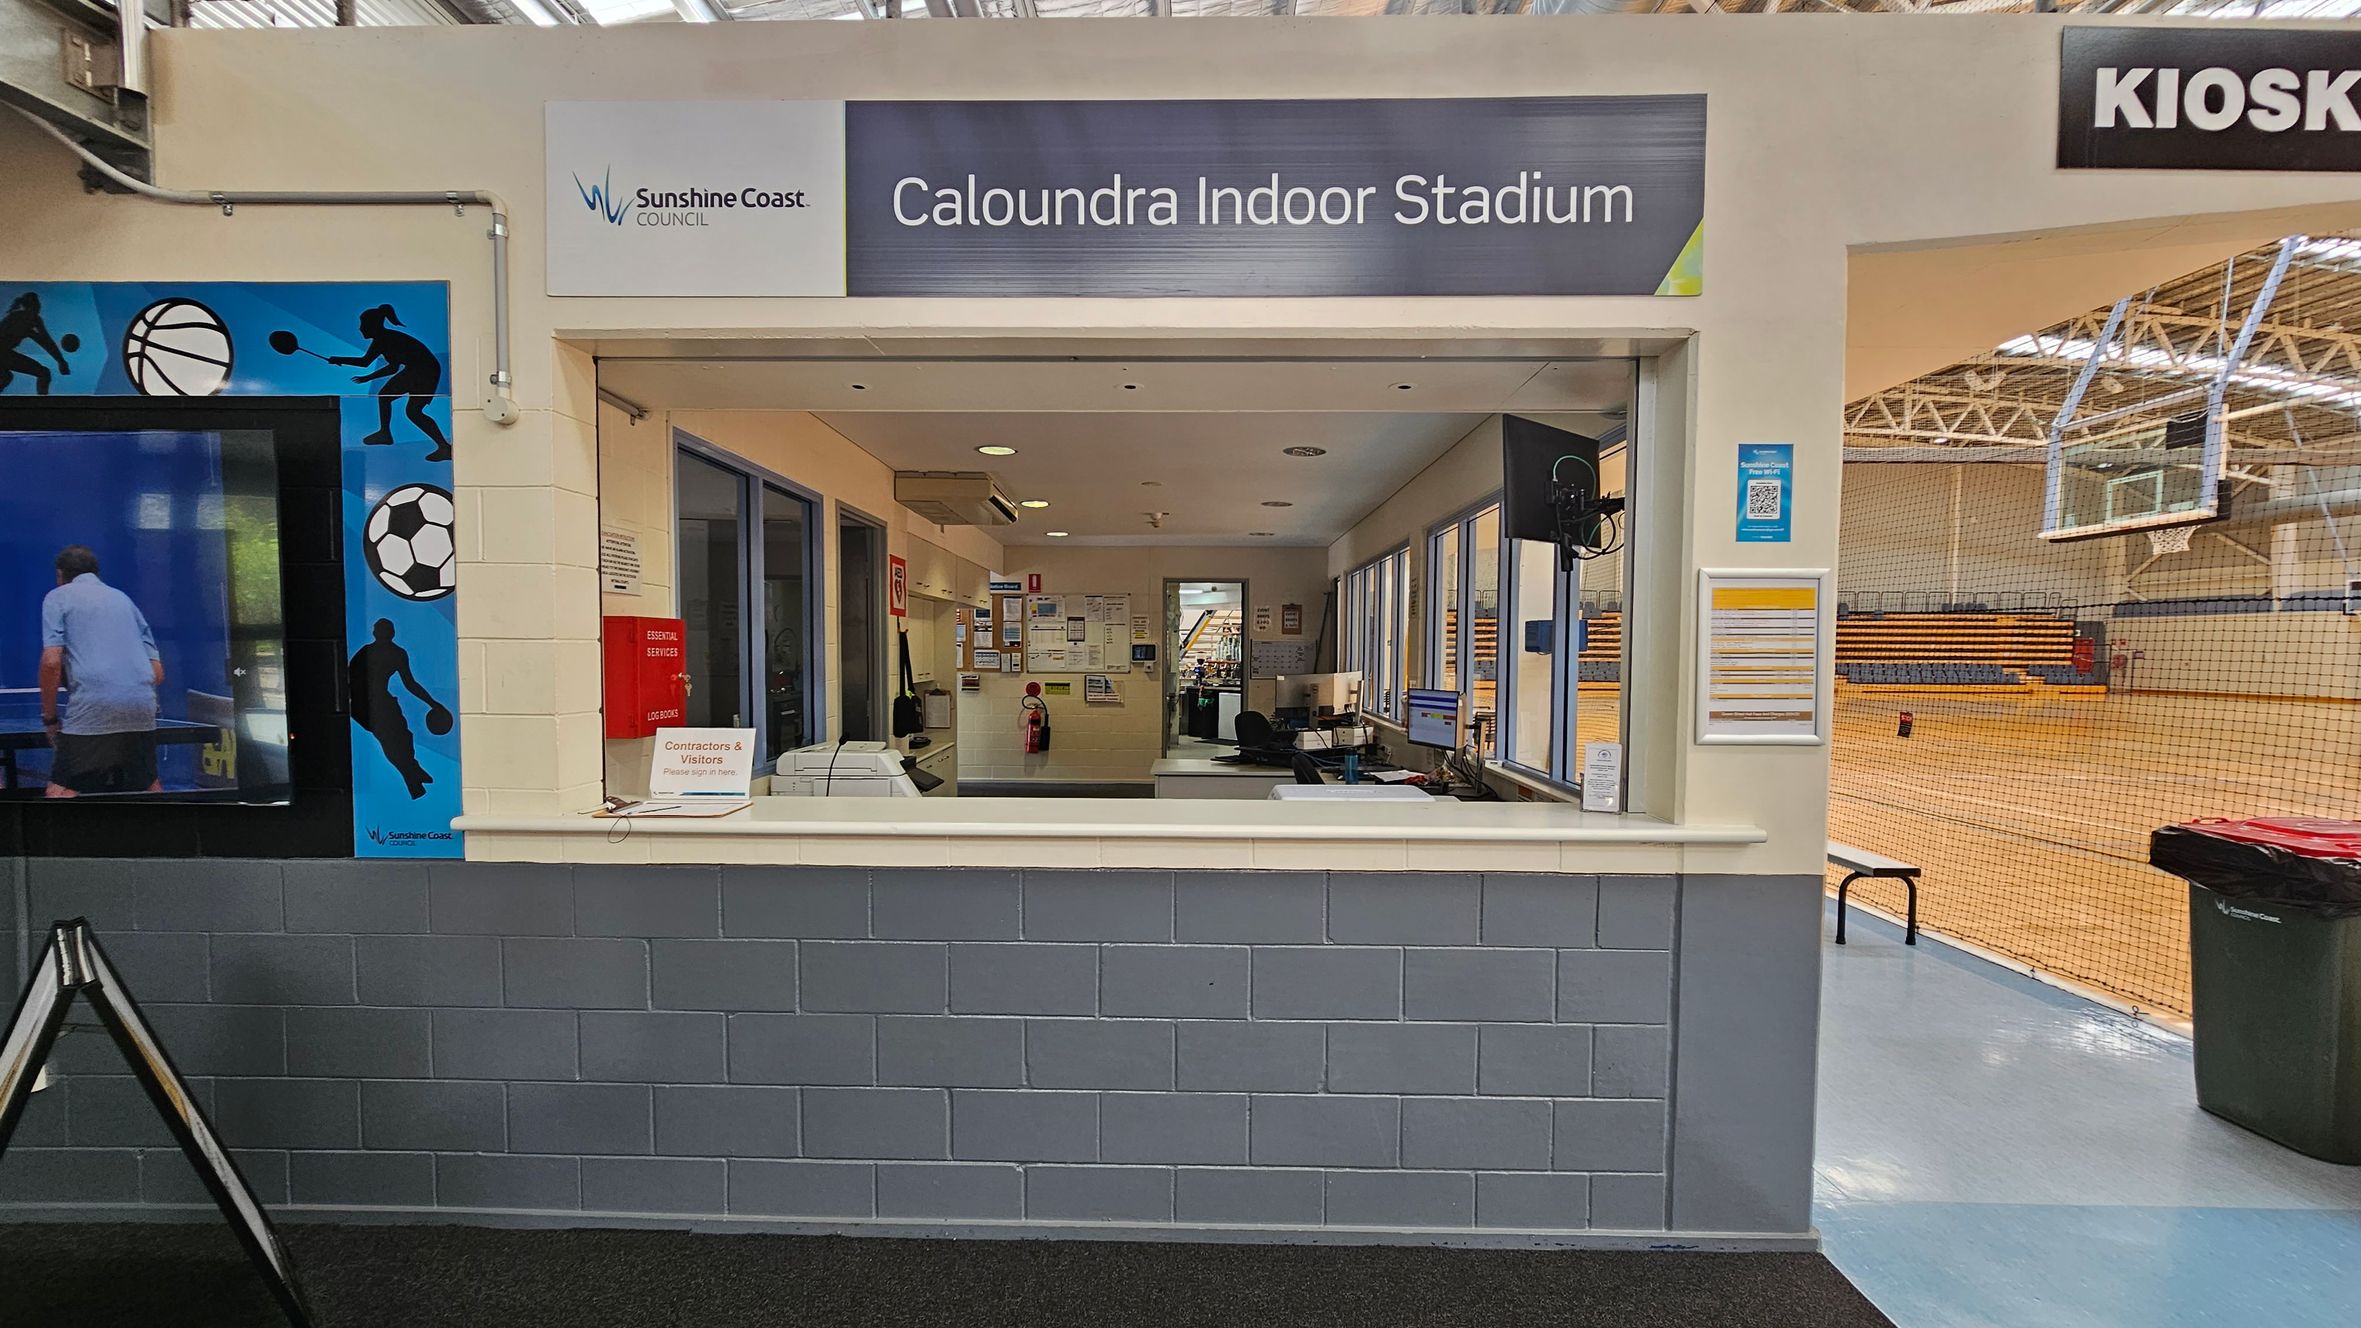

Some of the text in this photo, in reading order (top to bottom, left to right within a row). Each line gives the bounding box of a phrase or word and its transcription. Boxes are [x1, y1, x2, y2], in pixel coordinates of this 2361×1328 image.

[2094, 67, 2361, 132] KIOSK
[635, 187, 806, 209] Sunshine Coast
[893, 171, 1634, 227] Caloundra Indoor Stadium
[636, 213, 709, 227] COUNCIL
[646, 630, 679, 641] ESSENTIAL
[646, 647, 679, 657] SERVICES
[647, 708, 679, 721] LOG BOOKS
[665, 740, 743, 751] Contractors &
[680, 754, 724, 765] Visitors
[663, 767, 690, 776] Please
[691, 767, 708, 778] sign
[709, 767, 716, 776] in
[388, 831, 453, 840] Sunshine Coast
